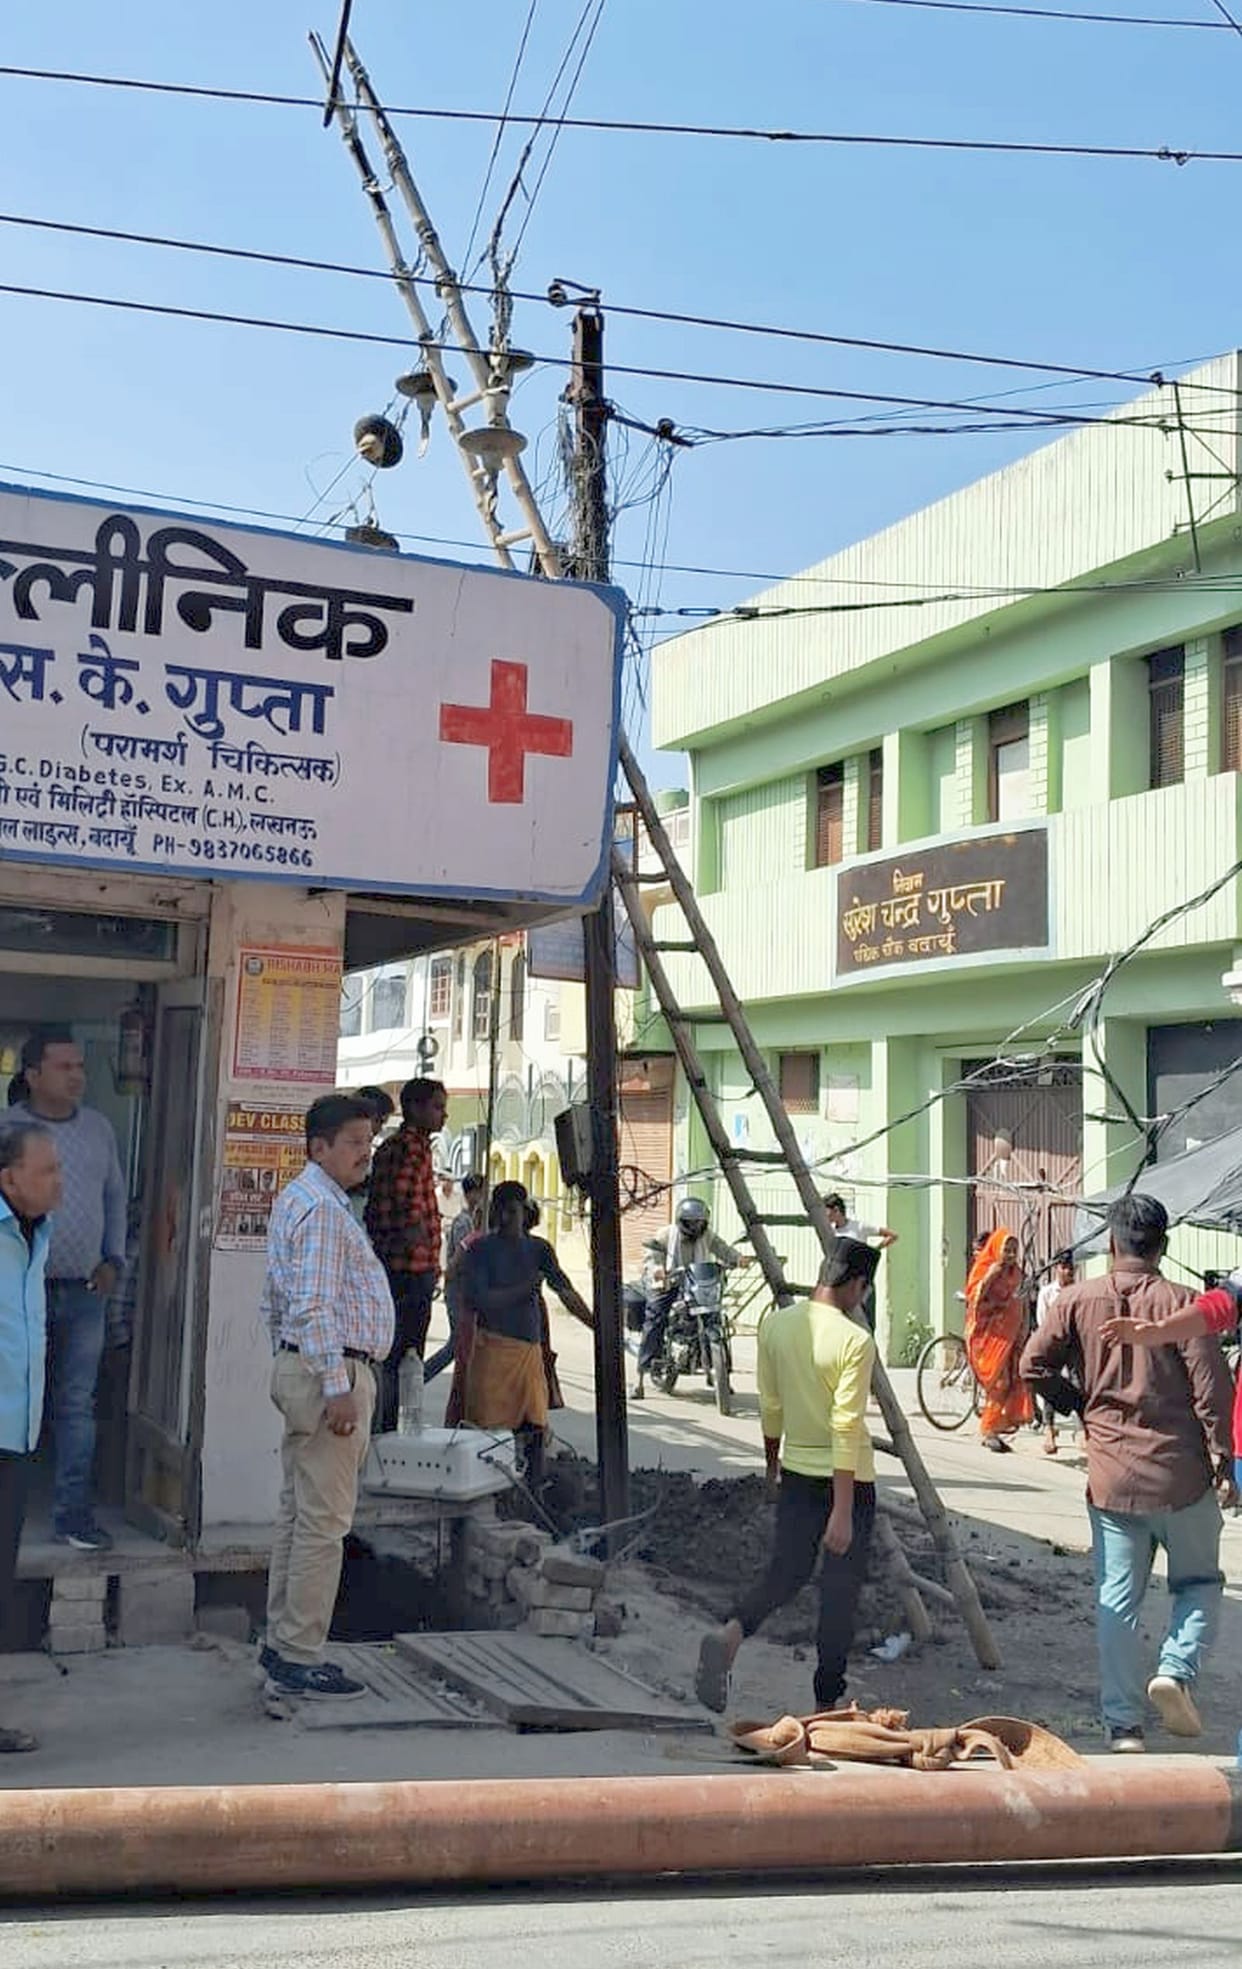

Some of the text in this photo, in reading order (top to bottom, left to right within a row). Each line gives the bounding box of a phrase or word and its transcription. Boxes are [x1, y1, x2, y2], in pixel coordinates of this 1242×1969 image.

[0, 514, 414, 661] लीनिक
[77, 633, 151, 715] के.
[165, 664, 335, 740] गुप्ता
[81, 723, 341, 788] (परामर्श चिकित्सक)
[15, 782, 41, 809] एवं
[48, 784, 118, 818] मिलिट्री
[120, 793, 200, 827] हॉस्पिटल
[250, 813, 318, 840] लखनऊ
[162, 774, 193, 794] Ex.
[203, 780, 275, 804] A.M.C.
[153, 833, 313, 868] PH-9837065866
[842, 879, 1006, 942] सुरेश चन्द्र गुप्ता
